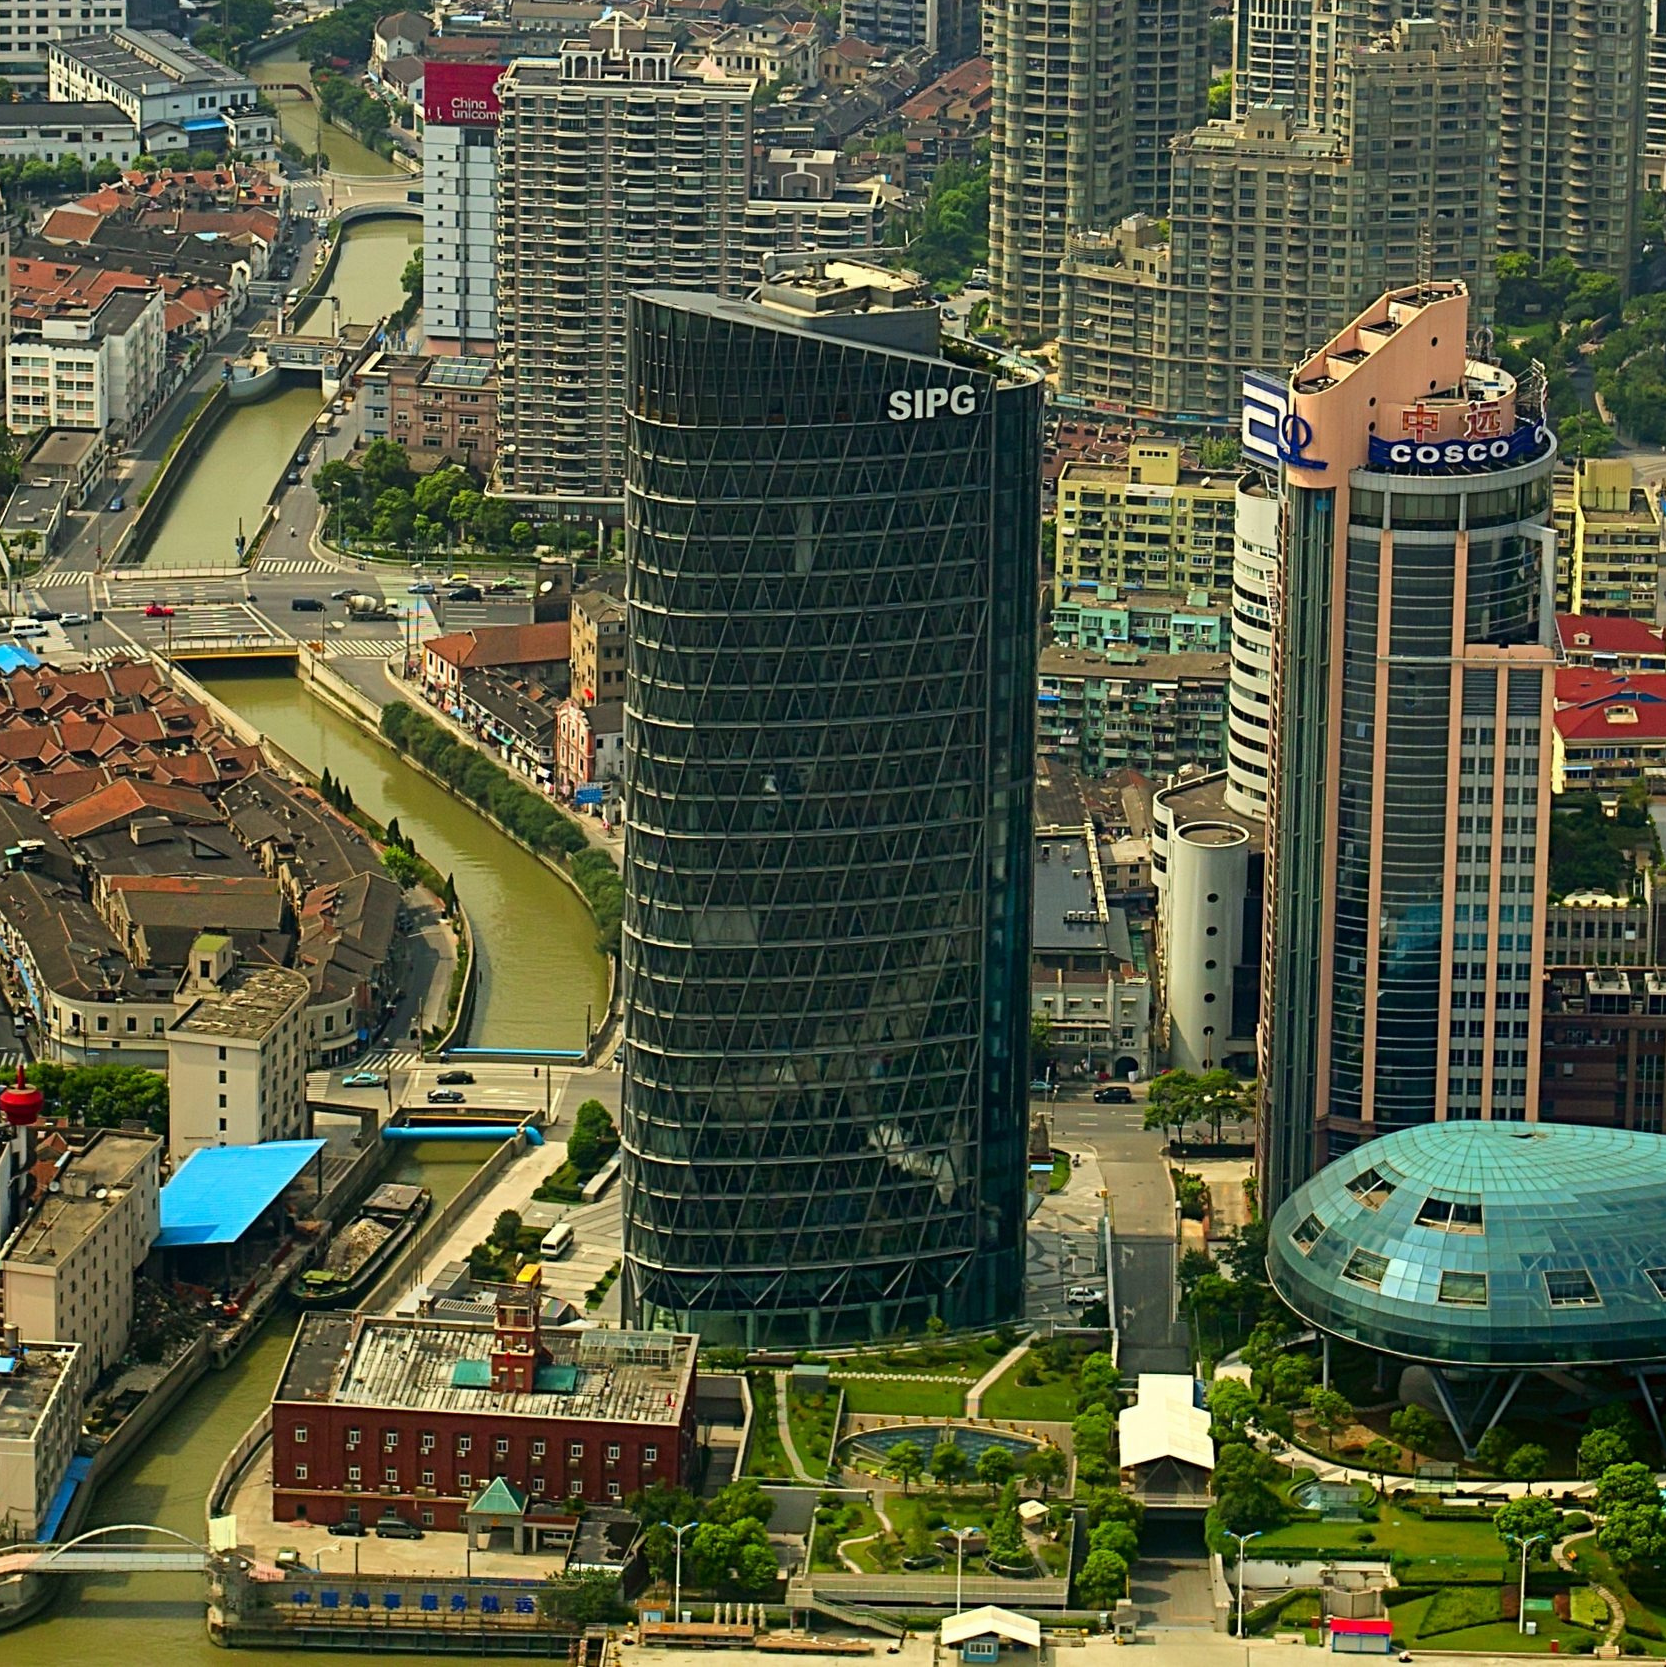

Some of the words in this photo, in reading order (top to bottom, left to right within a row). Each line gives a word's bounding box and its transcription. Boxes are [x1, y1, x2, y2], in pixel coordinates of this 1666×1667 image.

[451, 97, 487, 110] China
[452, 109, 497, 121] unicom
[887, 384, 976, 421] SIPG
[1400, 400, 1502, 444] 中远
[1390, 439, 1510, 464] COSCO
